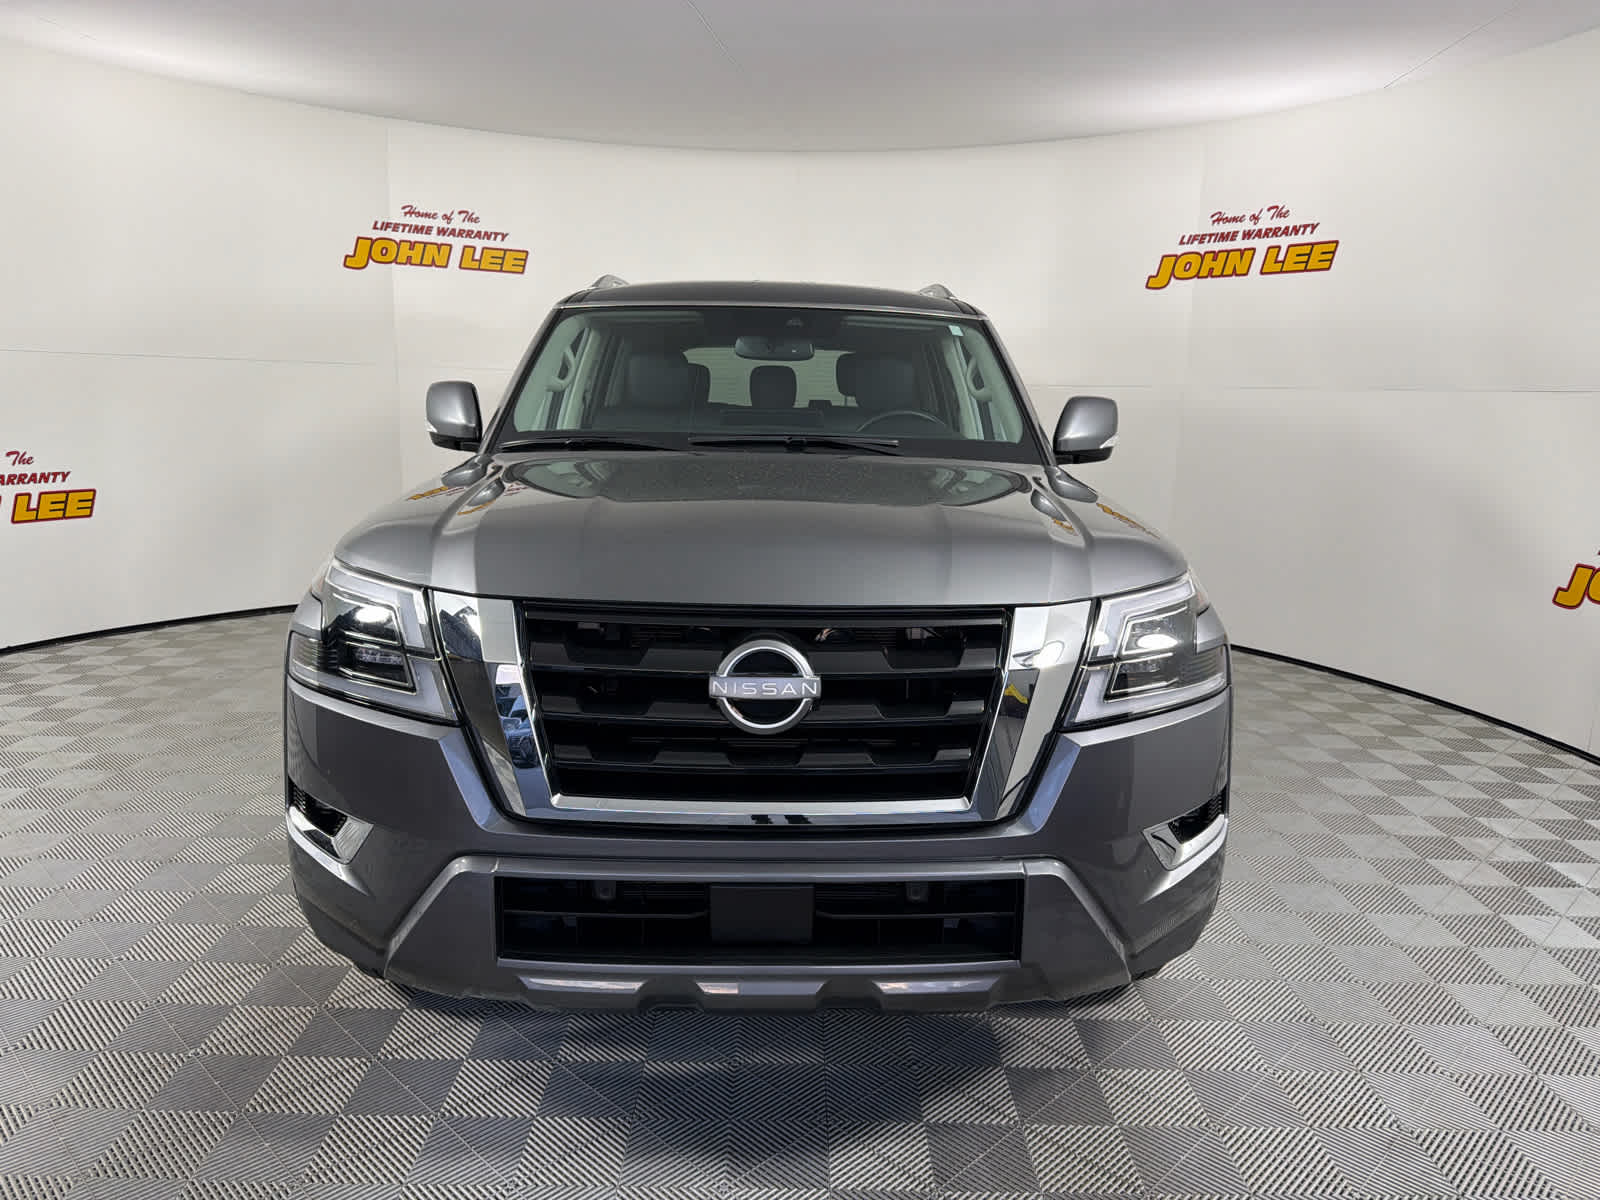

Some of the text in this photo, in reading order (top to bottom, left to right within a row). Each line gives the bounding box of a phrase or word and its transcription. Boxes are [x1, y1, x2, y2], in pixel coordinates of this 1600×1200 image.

[401, 204, 480, 224] Home of The
[1210, 204, 1290, 225] Home of The
[372, 220, 509, 242] LIFETIME WARRANTY
[1179, 222, 1320, 246] LIFETIME WARRANTY
[343, 236, 529, 274] JOHN LEE
[1145, 239, 1339, 290] JOHN LEE
[5, 450, 34, 466] The
[11, 488, 96, 524] LEE
[712, 681, 817, 696] NISSAN
